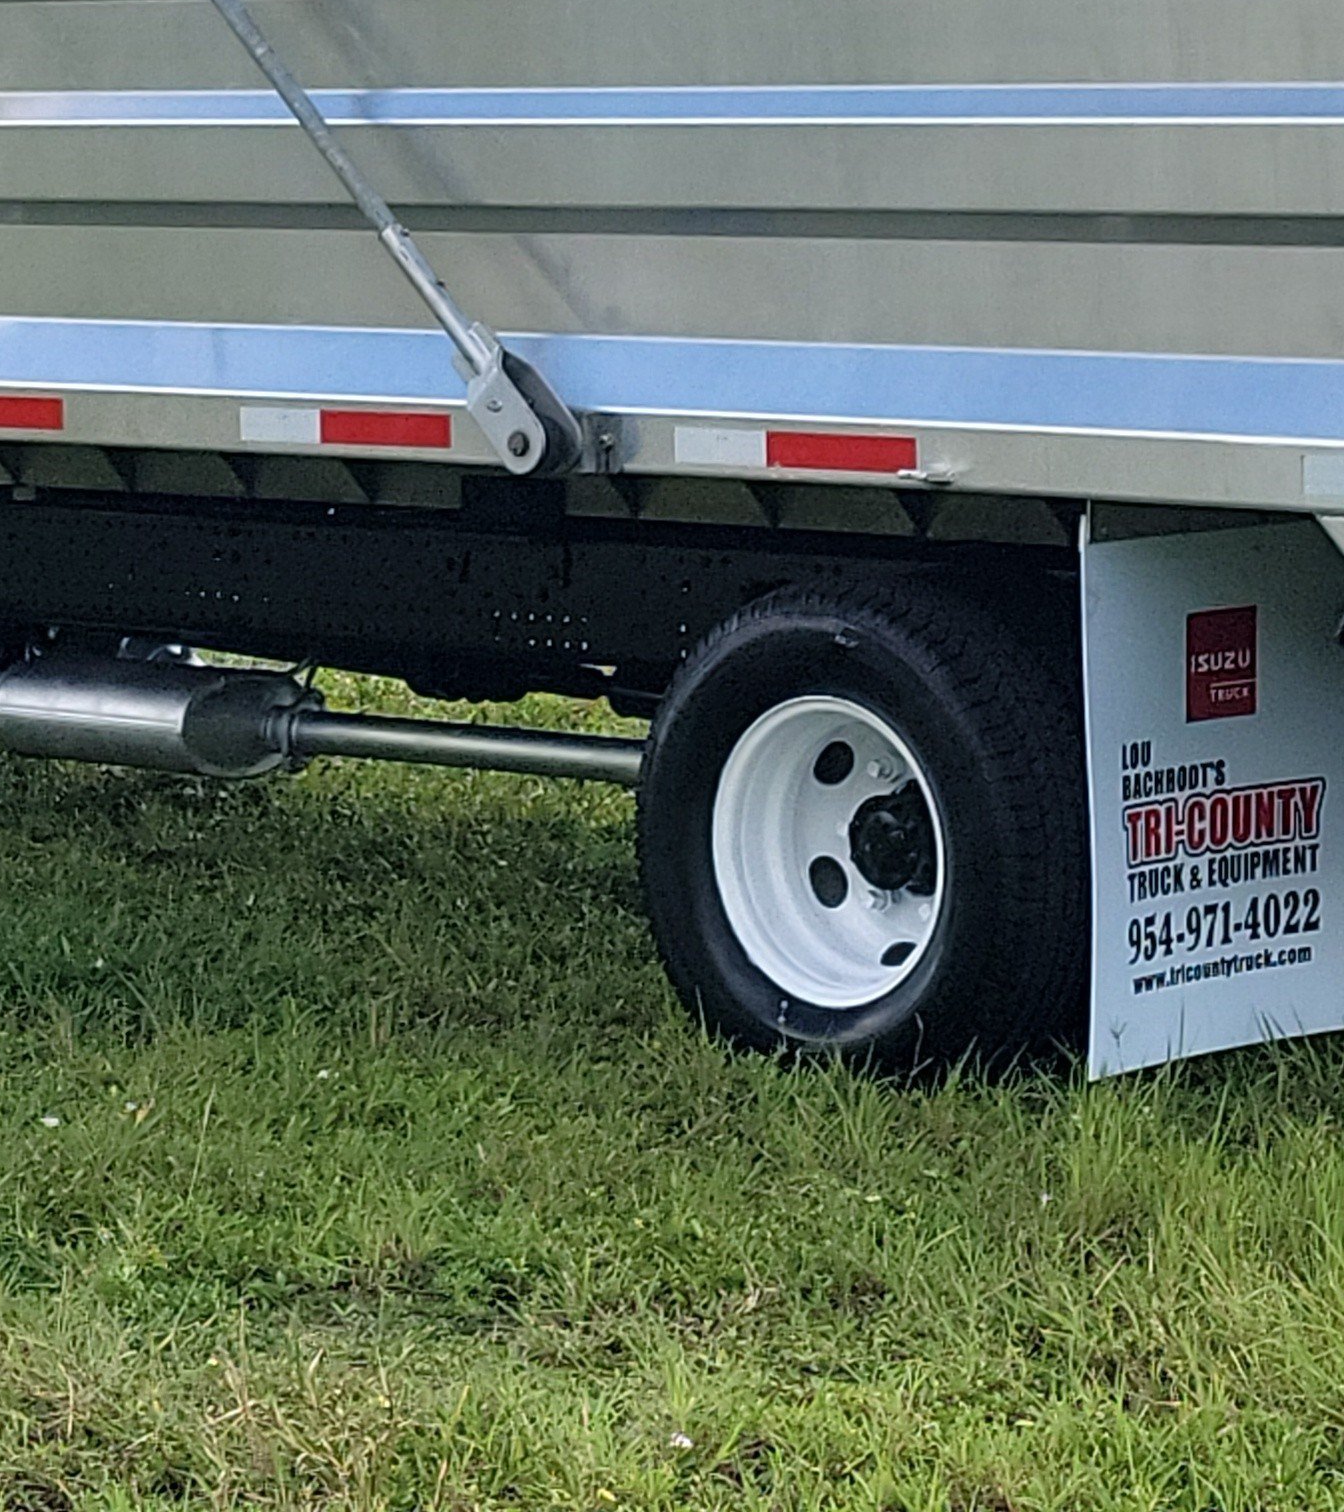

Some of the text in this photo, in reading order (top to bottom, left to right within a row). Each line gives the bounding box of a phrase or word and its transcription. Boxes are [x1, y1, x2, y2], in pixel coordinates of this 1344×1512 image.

[1191, 649, 1251, 674] ISUZU
[1210, 687, 1250, 703] TRUCK
[1122, 741, 1151, 770] LOU
[1126, 781, 1323, 864] TRI-COUNTY
[1127, 844, 1320, 903] TRUCK & EQUIPMENT
[1128, 888, 1321, 966] 954-971-4022
[1133, 946, 1313, 995] www.tricountytruck.com
